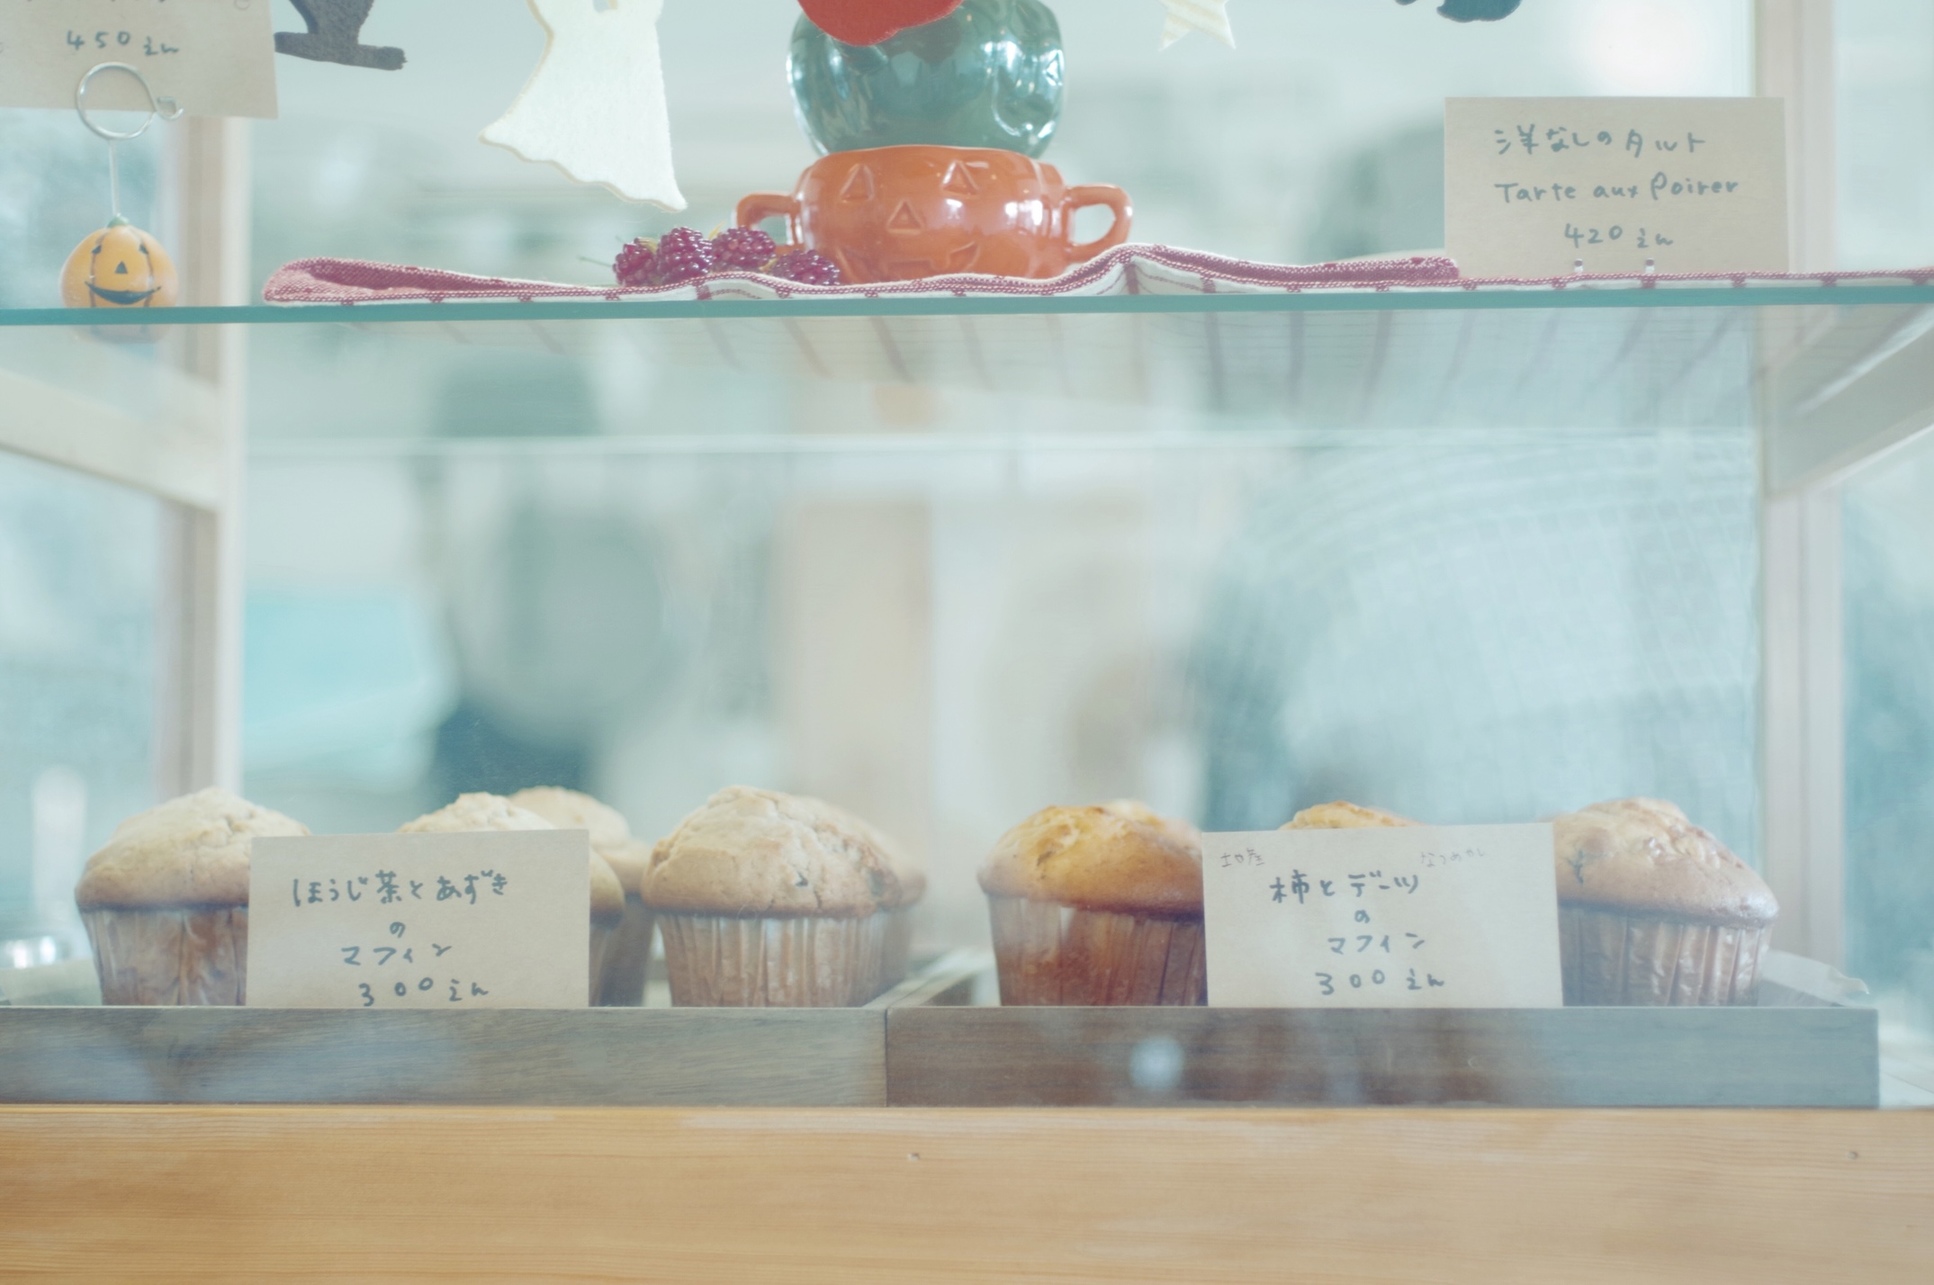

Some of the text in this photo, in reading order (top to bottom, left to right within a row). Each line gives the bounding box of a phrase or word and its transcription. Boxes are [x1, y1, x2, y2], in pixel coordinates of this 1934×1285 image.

[1494, 182, 1577, 203] Tarte
[1593, 184, 1638, 200] aux
[293, 869, 508, 907] ほうじ茶とあずき
[1269, 869, 1419, 904] 柿とデーツ
[1354, 909, 1371, 924] の
[389, 921, 406, 938] の
[340, 943, 452, 966] マフィン
